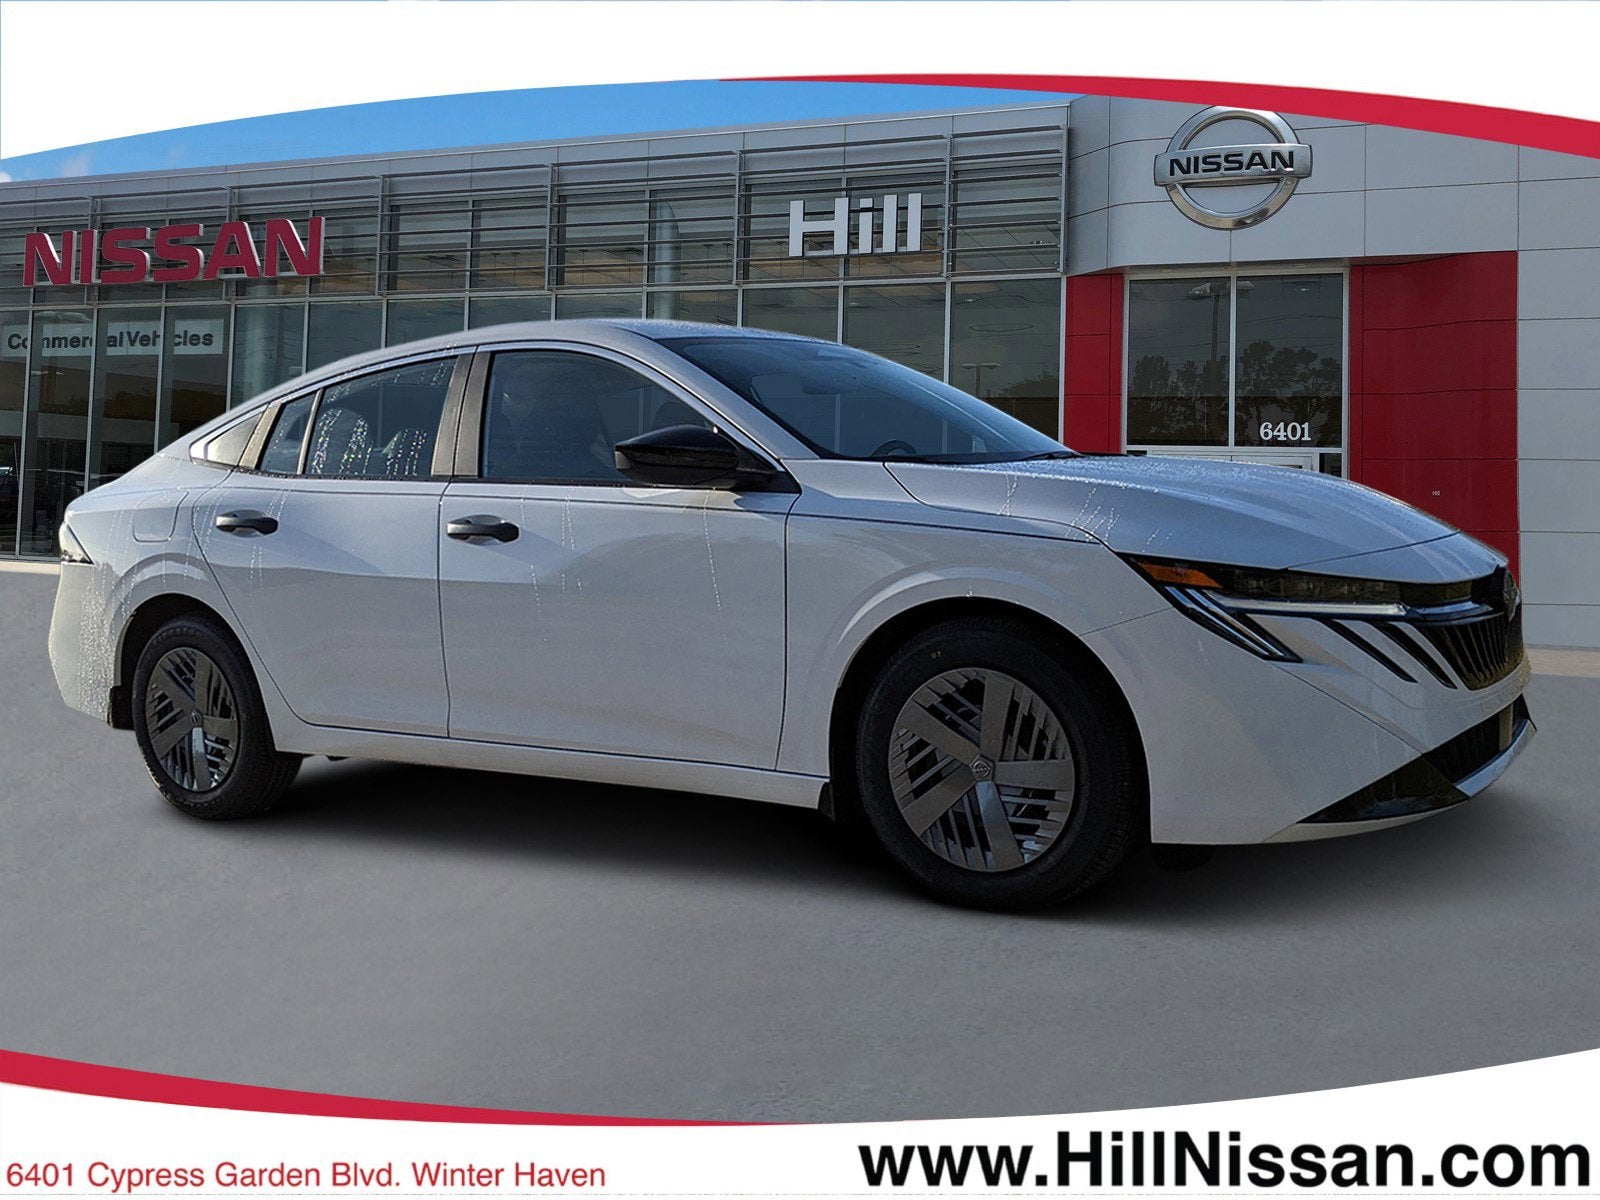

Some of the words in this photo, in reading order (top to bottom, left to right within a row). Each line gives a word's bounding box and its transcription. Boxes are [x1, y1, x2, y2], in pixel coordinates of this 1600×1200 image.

[1169, 150, 1295, 177] NISSAN
[788, 192, 922, 257] Hill
[23, 216, 325, 287] NISSAN
[7, 330, 124, 350] Commeral
[126, 329, 214, 348] Vehcles
[1259, 421, 1312, 441] 6401
